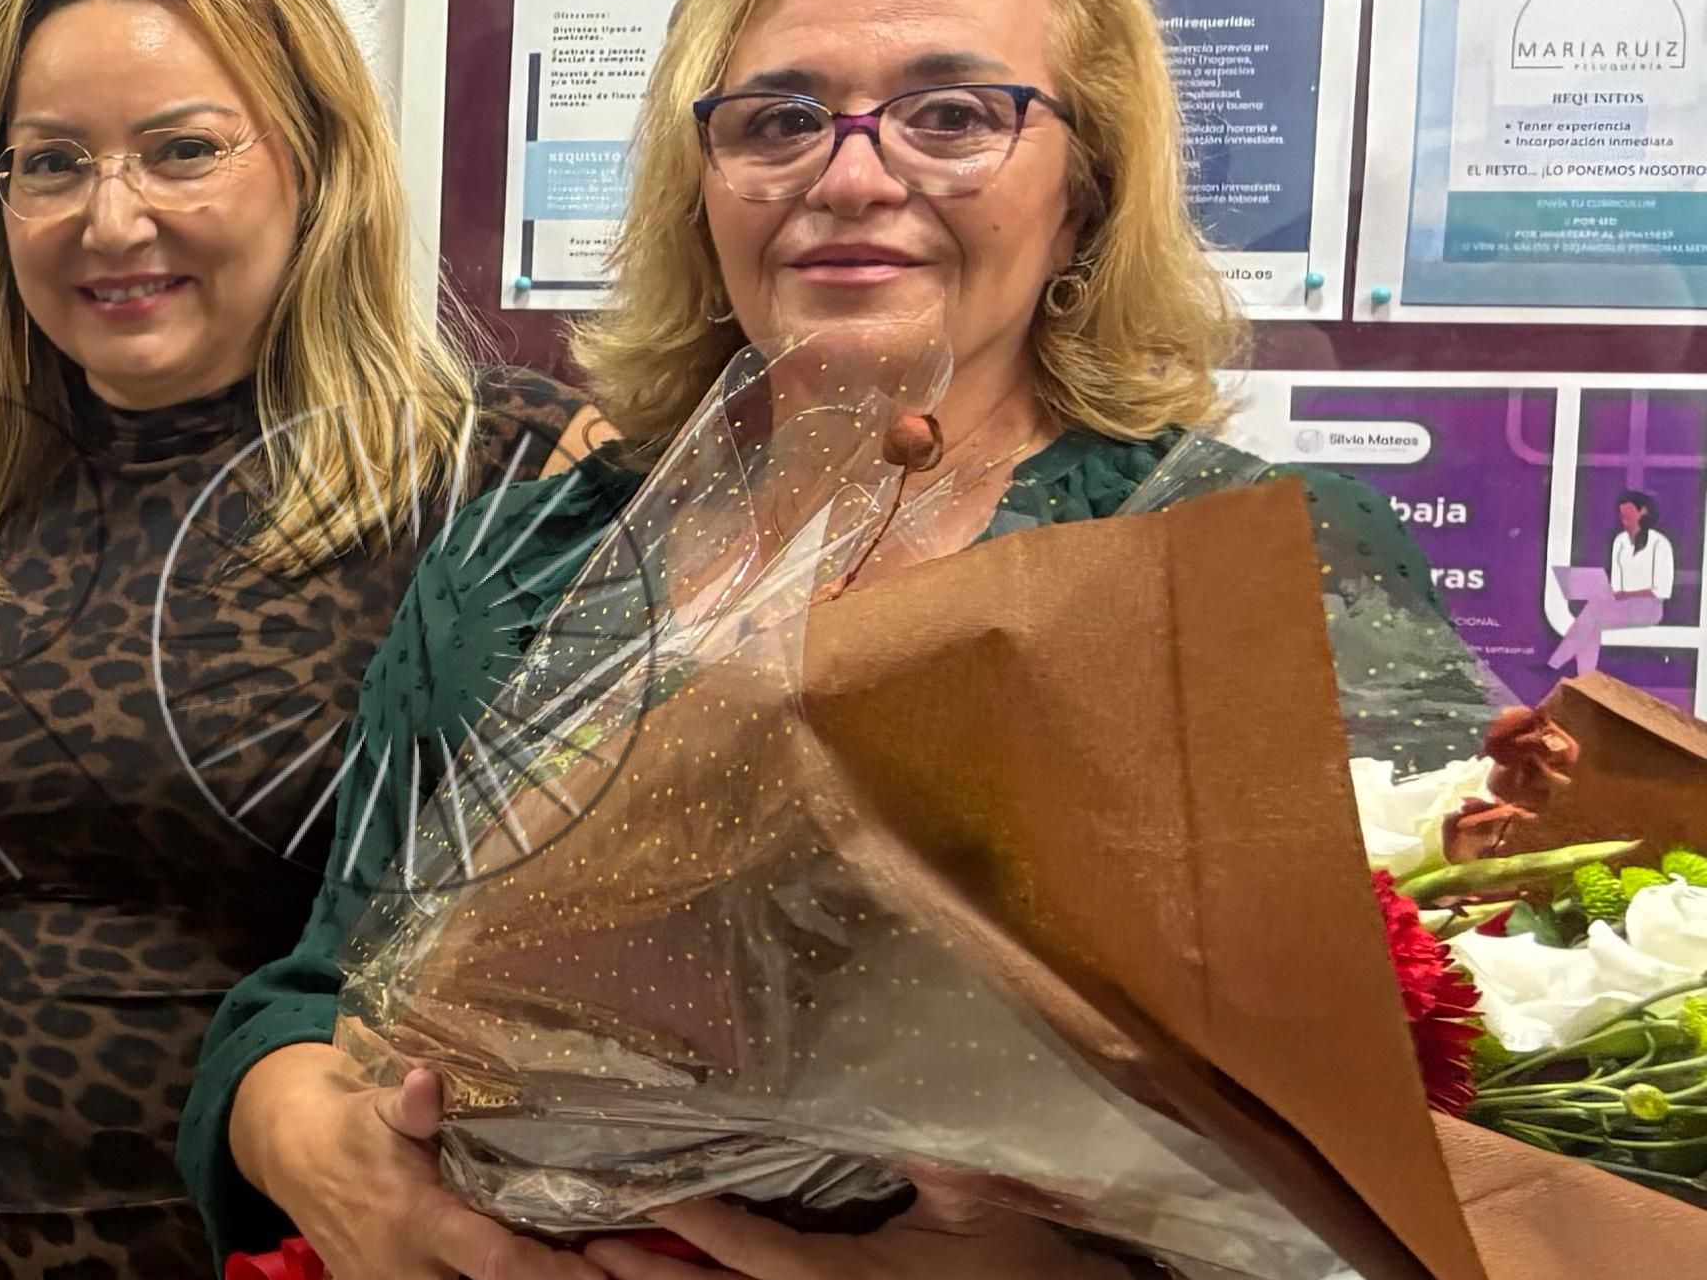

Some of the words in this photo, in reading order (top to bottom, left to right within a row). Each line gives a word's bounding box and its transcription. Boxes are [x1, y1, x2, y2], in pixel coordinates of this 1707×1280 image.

[1616, 41, 1679, 57] RUIZ
[1517, 121, 1552, 131] Tener
[1557, 122, 1631, 133] experiencia
[1516, 137, 1605, 148] Incorporación
[1609, 137, 1674, 147] inmediata
[1467, 165, 1481, 176] EL
[1567, 165, 1635, 176] PONEMOS
